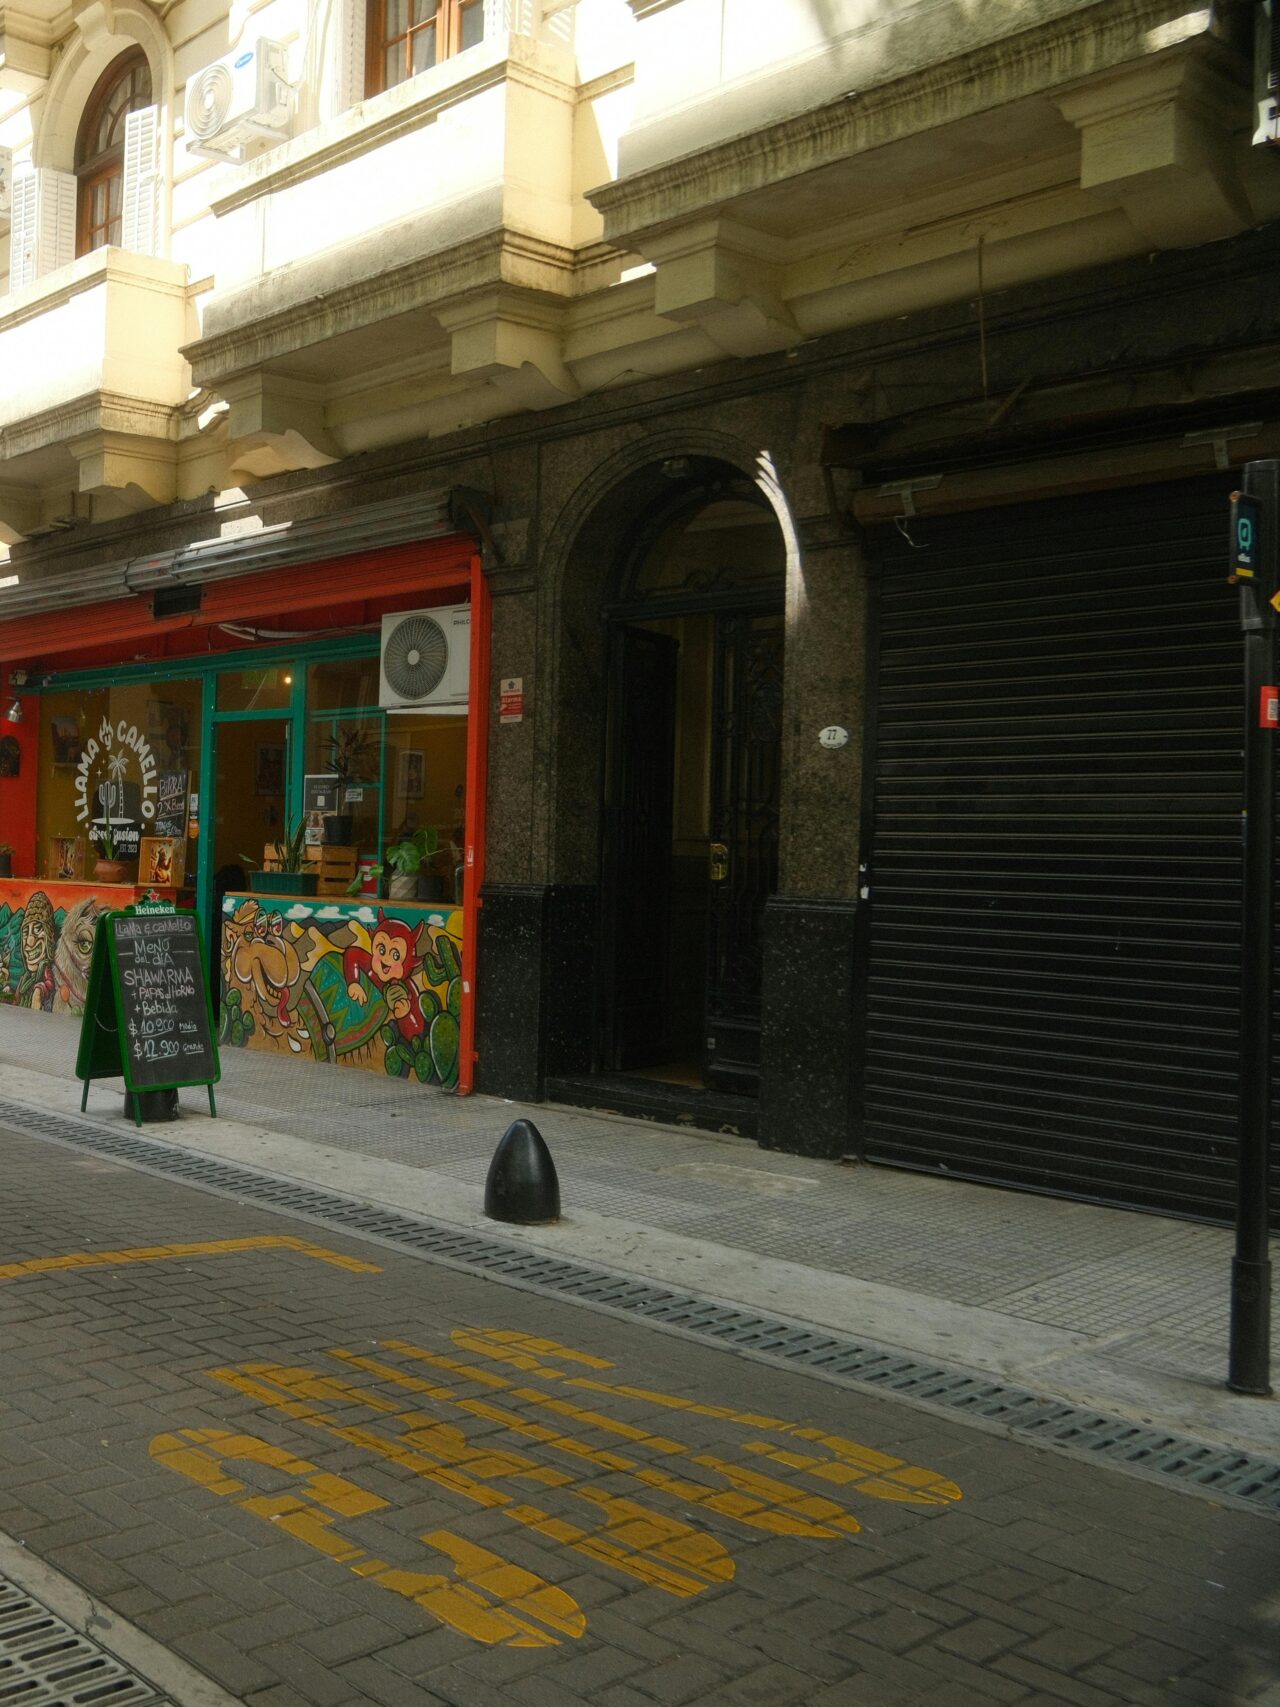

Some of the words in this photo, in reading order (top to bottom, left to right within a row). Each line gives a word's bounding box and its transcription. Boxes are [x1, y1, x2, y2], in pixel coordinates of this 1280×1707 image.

[827, 729, 837, 740] 77
[75, 738, 100, 821] LLAMA
[117, 720, 157, 818] CAMELLO
[135, 905, 176, 915] Heineken
[124, 966, 193, 987] SHAWARMA
[142, 1000, 177, 1016] Bebida
